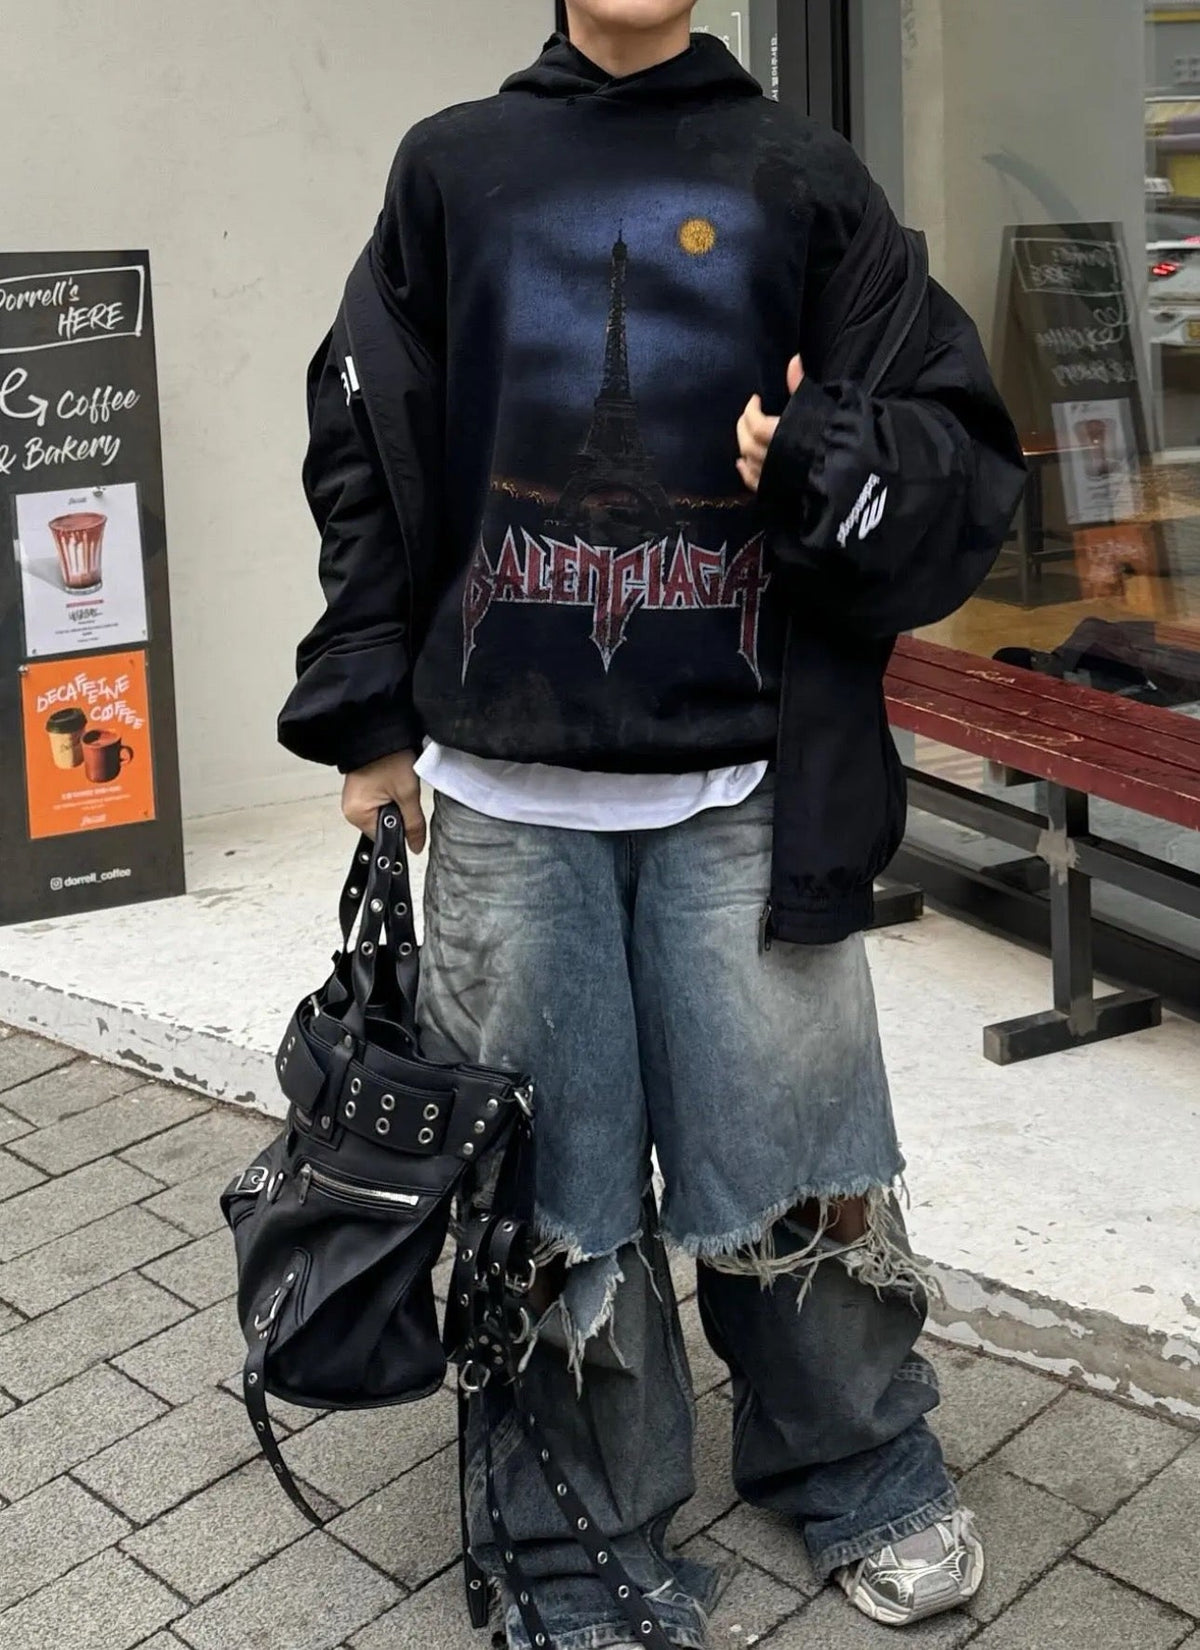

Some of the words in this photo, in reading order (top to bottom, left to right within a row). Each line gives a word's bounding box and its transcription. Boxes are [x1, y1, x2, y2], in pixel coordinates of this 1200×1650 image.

[58, 302, 125, 340] HERE
[57, 385, 140, 424] Coffee
[22, 435, 121, 471] Bakery
[462, 521, 771, 693] BALENCIAGA
[90, 699, 145, 730] COFFEE
[64, 867, 132, 888] dorrell_coffee
